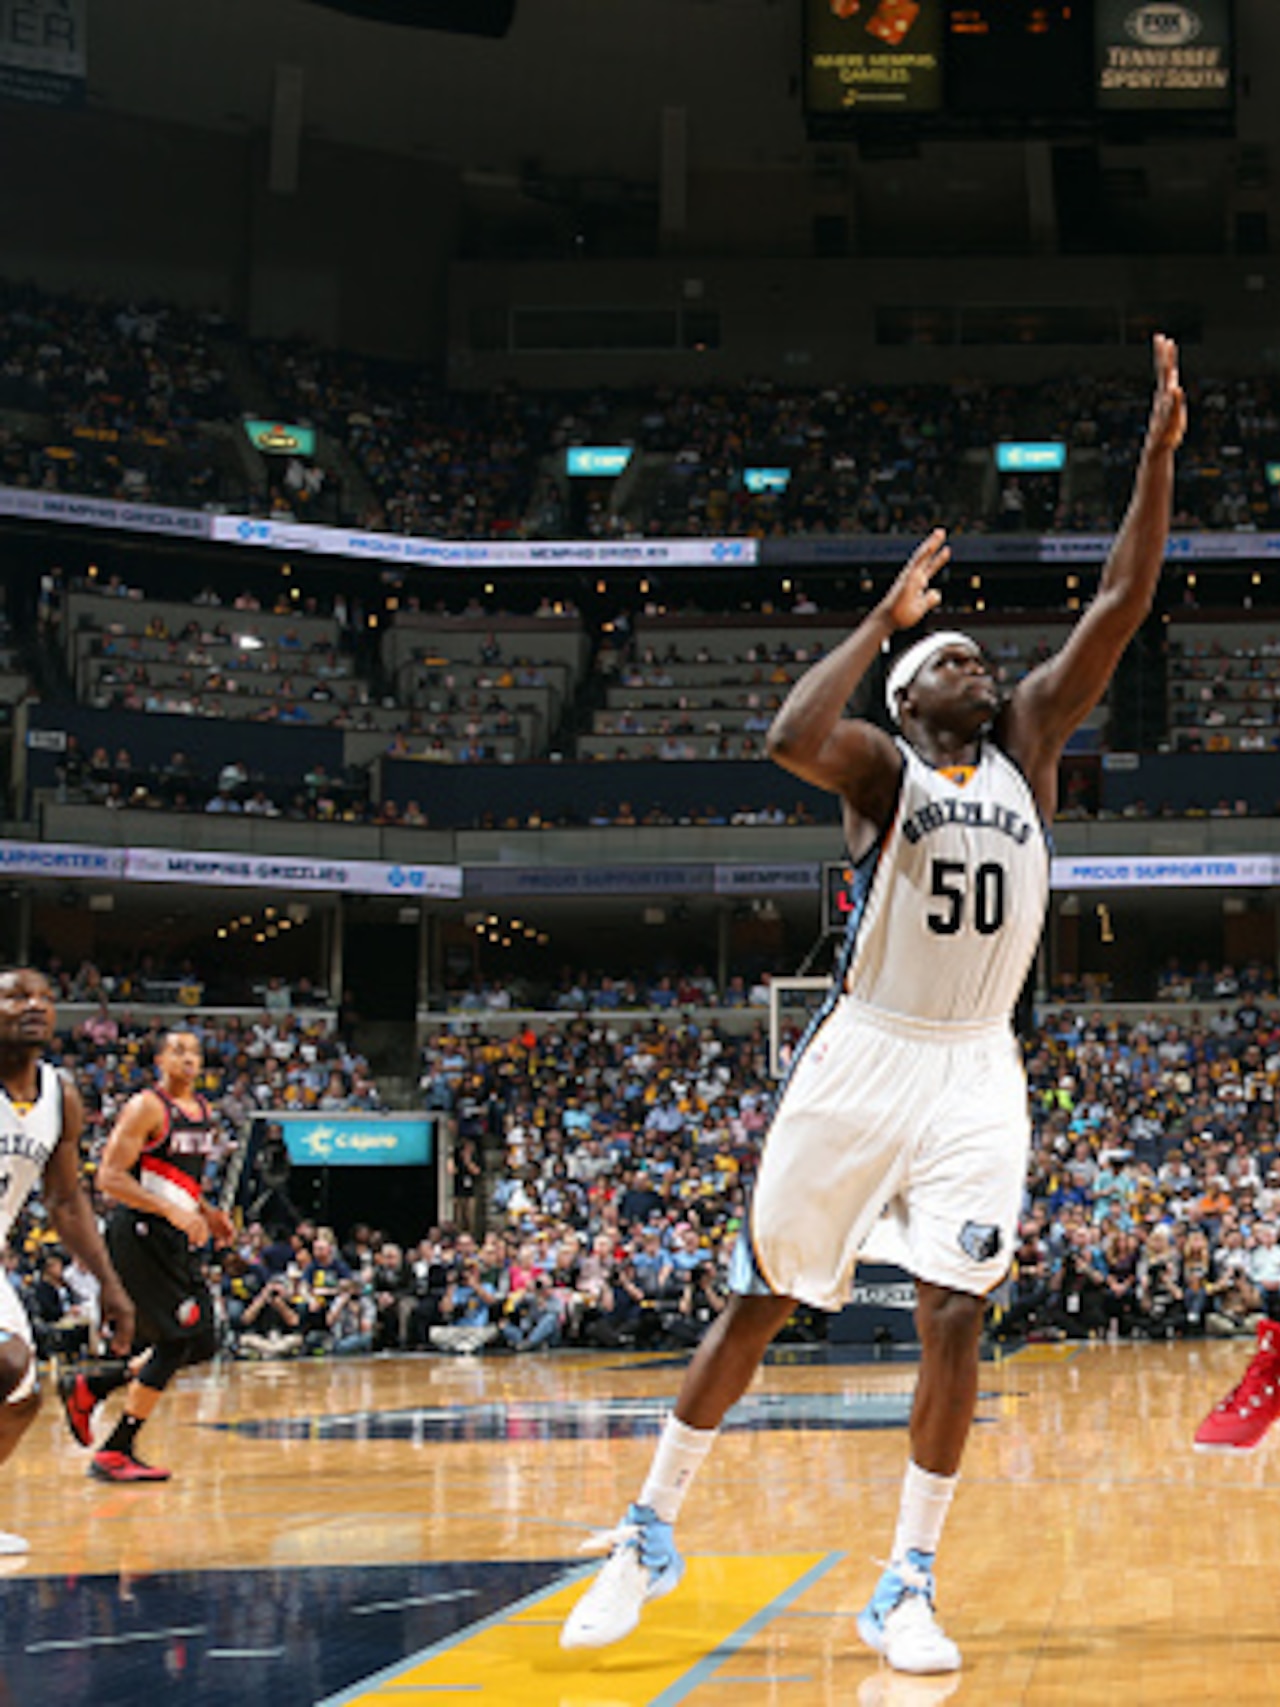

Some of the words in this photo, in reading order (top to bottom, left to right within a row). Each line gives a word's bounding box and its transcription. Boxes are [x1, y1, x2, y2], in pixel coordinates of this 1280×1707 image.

[1107, 47, 1221, 67] TENNESSEE
[1100, 68, 1230, 89] SPORTSOUTH
[902, 799, 1033, 845] GRIZZLIES
[167, 857, 251, 879] MEMPHIS
[258, 861, 349, 884] GRIZZLIES
[582, 870, 687, 887] SUPPORTER
[733, 870, 810, 885] MEMPHIS
[1071, 865, 1129, 880] PROUD
[1134, 862, 1237, 880] SUPPORTER
[927, 858, 1004, 935] 50
